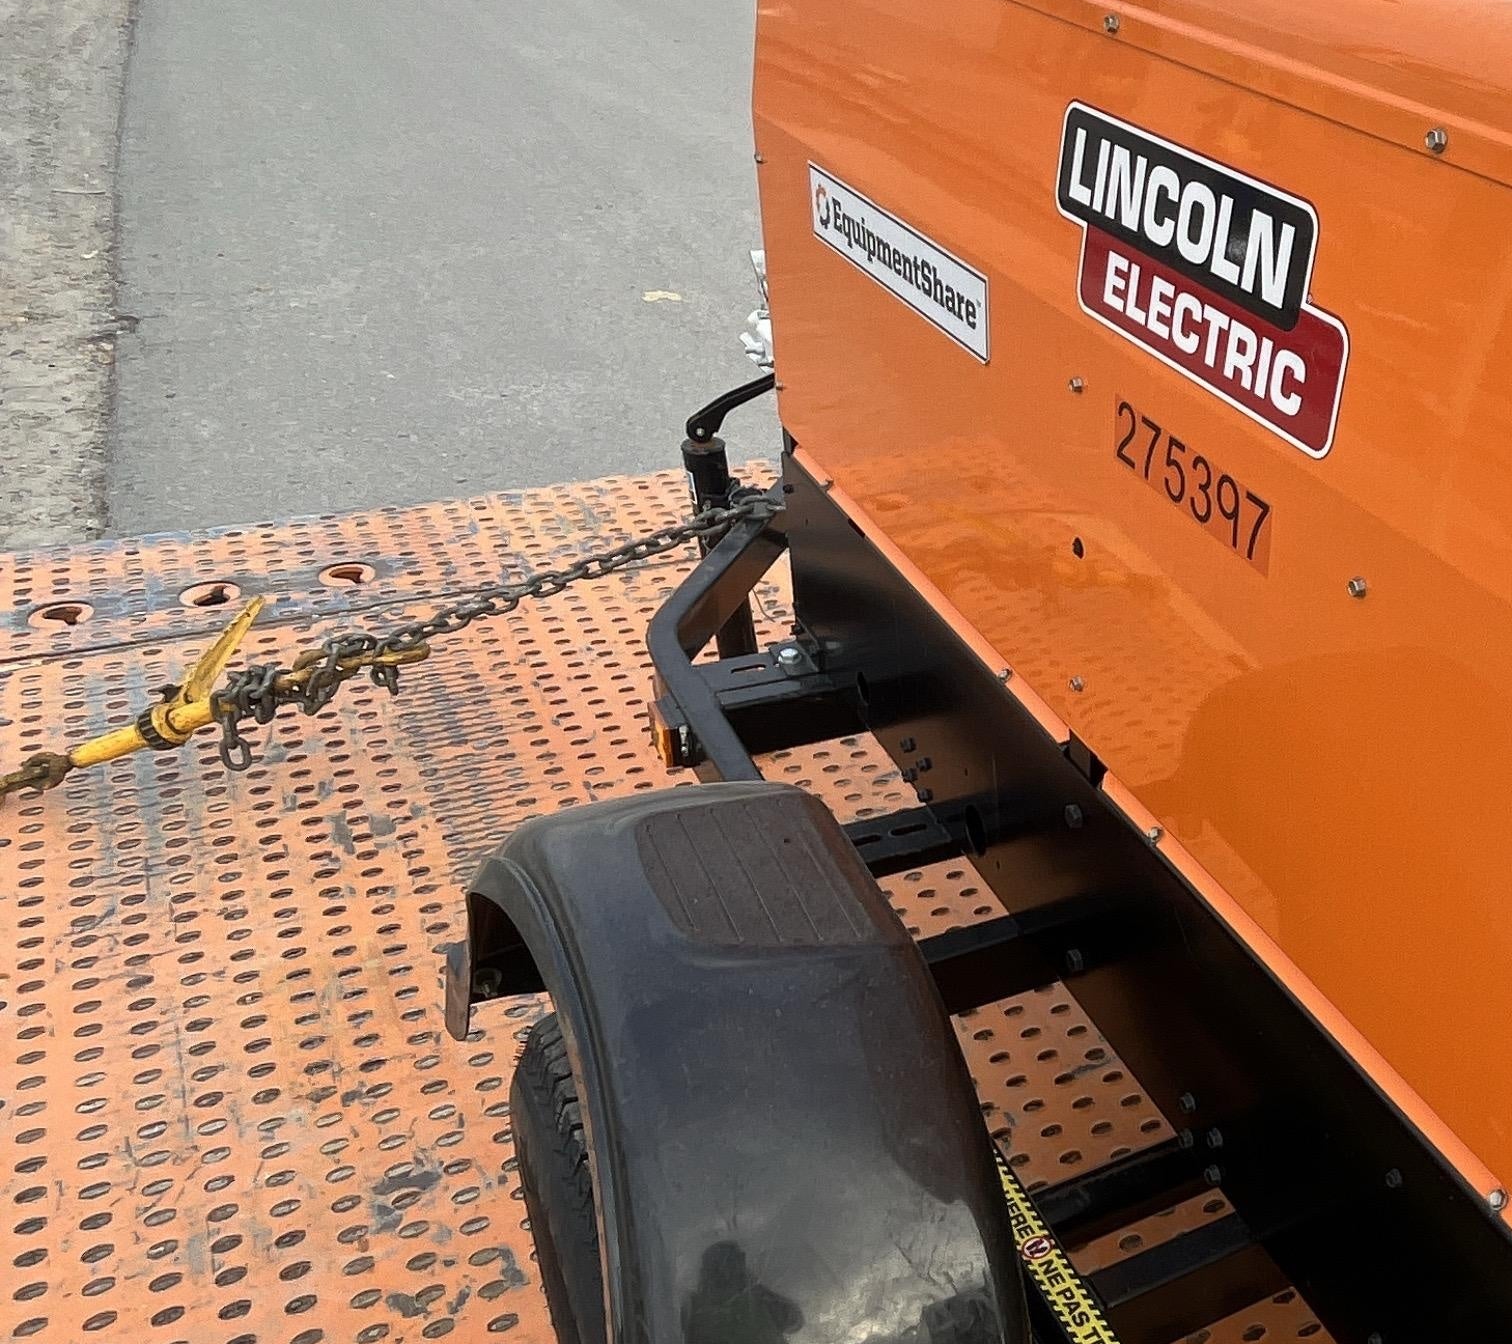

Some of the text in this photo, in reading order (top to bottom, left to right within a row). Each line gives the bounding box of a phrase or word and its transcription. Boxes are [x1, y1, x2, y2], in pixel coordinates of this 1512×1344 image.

[832, 196, 977, 330] EquipmentShare
[1068, 126, 1295, 309] LINCOLN
[1102, 249, 1306, 417] ELECTRIC
[1114, 400, 1272, 561] 275397
[1038, 1258, 1066, 1288] NE
[1056, 1286, 1091, 1328] PAS
